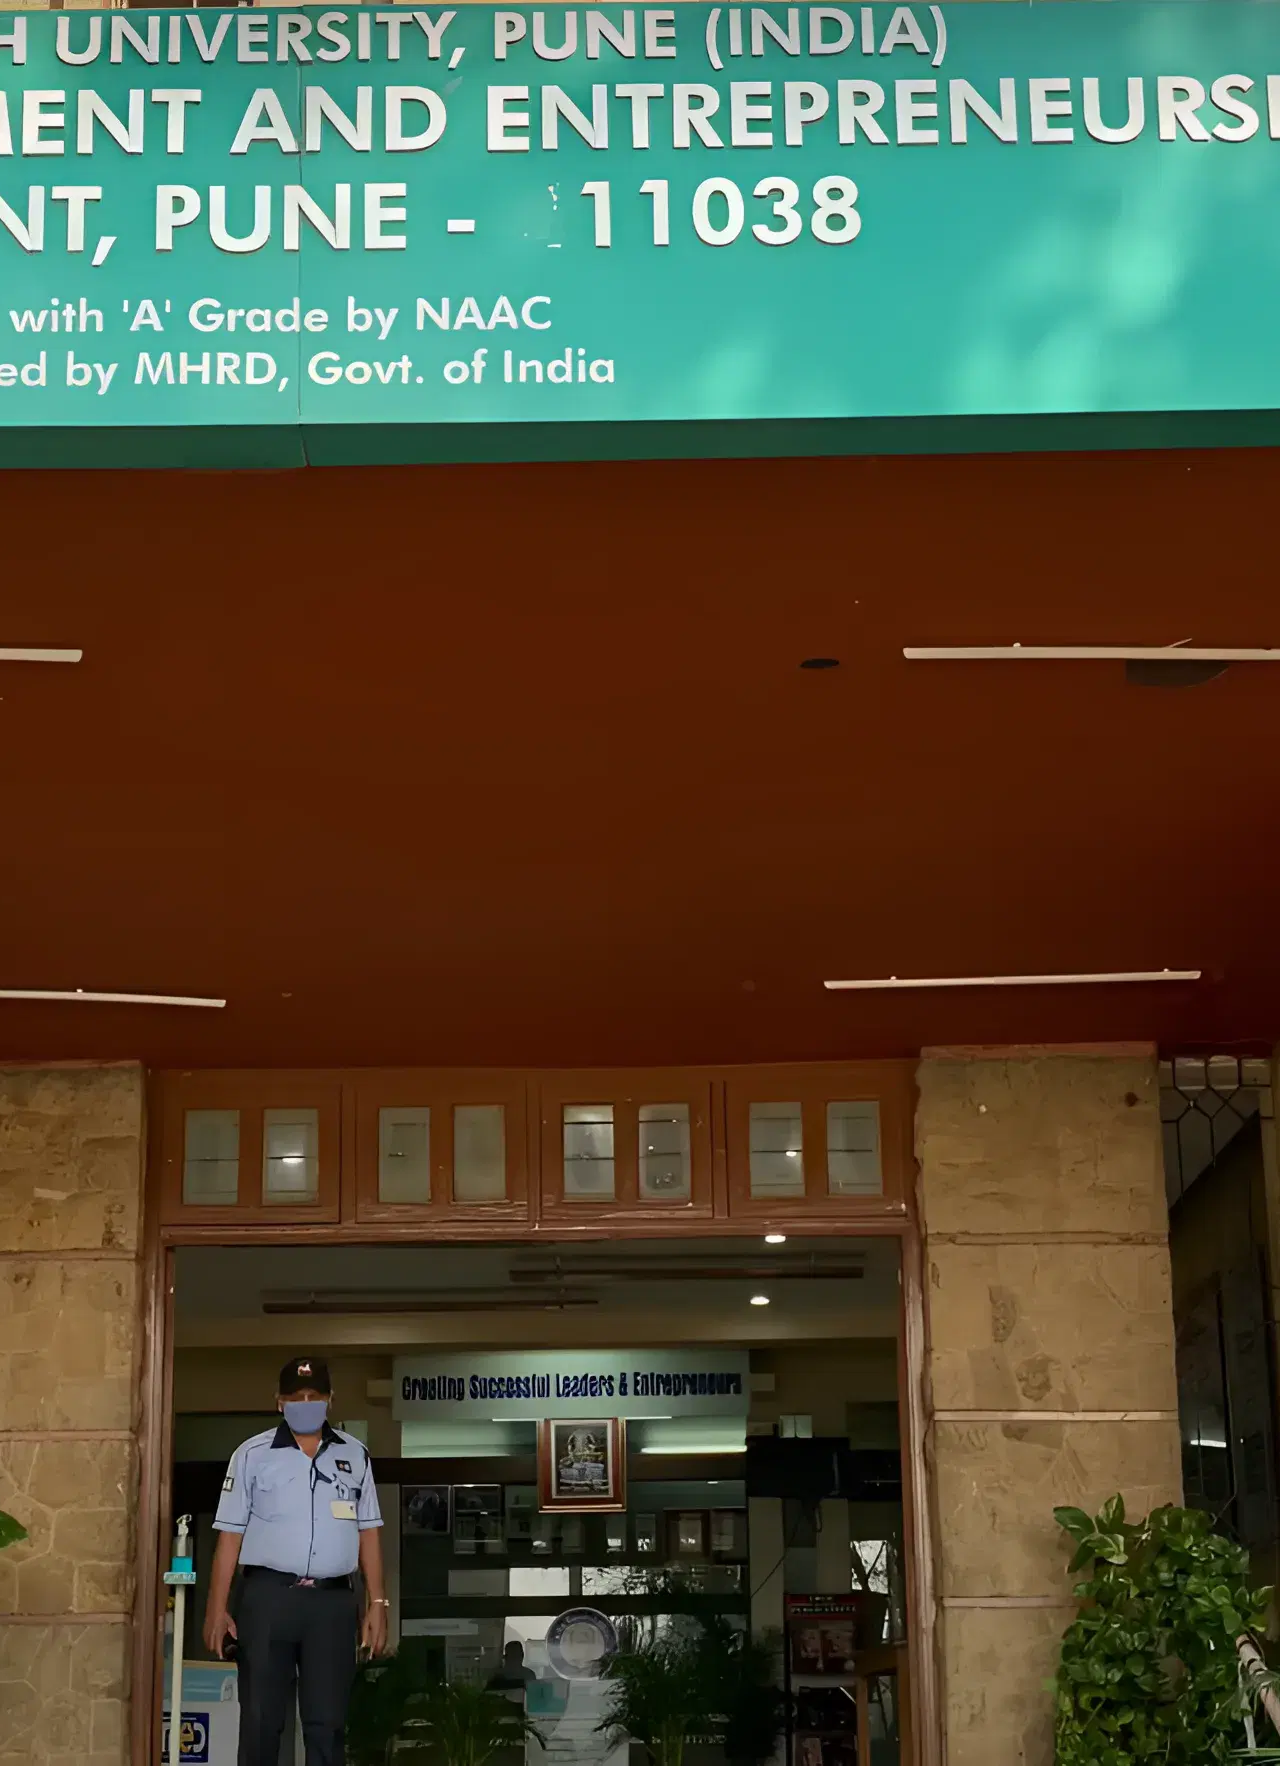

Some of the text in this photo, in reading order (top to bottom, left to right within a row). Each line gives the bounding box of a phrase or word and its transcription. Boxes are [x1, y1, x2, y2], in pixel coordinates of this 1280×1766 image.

[56, 12, 466, 69] UNIVERSITY,
[495, 10, 676, 59] PUNE
[706, 6, 946, 69] (INDIA)
[230, 86, 446, 153] AND
[156, 183, 406, 252] PUNE
[448, 220, 475, 232] -
[10, 298, 103, 332] with
[189, 297, 328, 332] Grade
[348, 296, 398, 340] by
[417, 296, 551, 330] NAAC
[66, 351, 117, 395] by
[135, 352, 288, 392] MHRD,
[308, 352, 423, 384] Govt.
[444, 349, 487, 384] of
[504, 348, 614, 383] India
[402, 1375, 465, 1401] Creating
[469, 1374, 550, 1399] Successful
[556, 1373, 614, 1398] Leaders
[632, 1372, 743, 1396] Entrepreneurs
